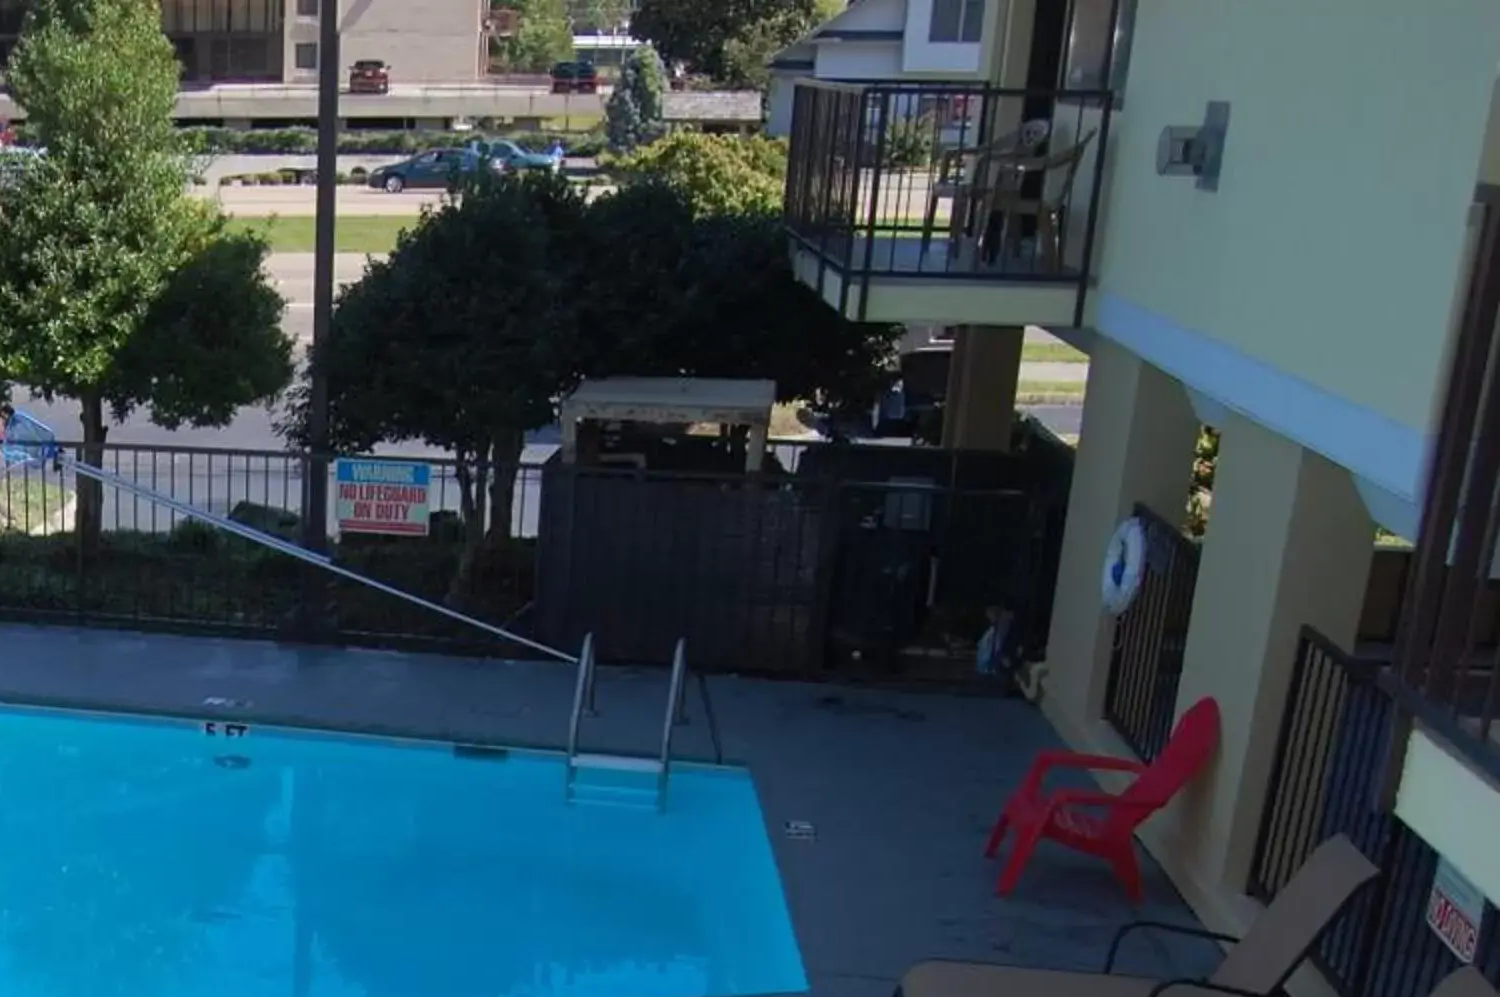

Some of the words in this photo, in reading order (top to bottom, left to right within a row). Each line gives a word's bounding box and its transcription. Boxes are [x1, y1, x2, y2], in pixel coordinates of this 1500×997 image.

[340, 483, 356, 499] NO
[359, 486, 425, 503] LIFEGUARD
[353, 502, 370, 518] ON
[376, 503, 409, 520] DUTY
